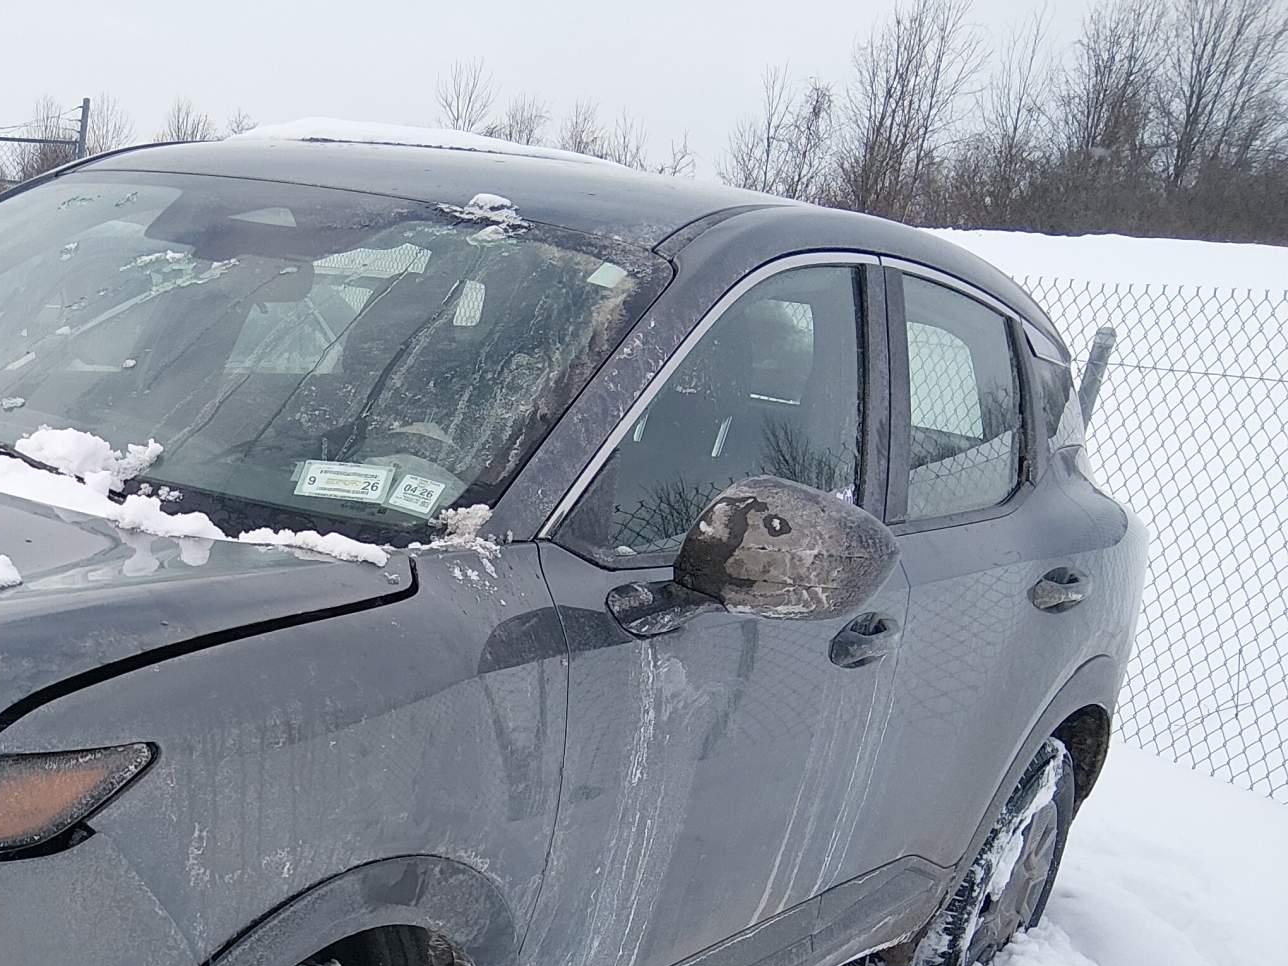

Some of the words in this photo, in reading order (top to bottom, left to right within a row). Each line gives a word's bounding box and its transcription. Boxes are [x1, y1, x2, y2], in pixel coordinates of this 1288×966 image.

[307, 475, 317, 486] 9
[360, 481, 380, 492] 26
[403, 483, 418, 494] 04
[419, 488, 434, 498] 26
